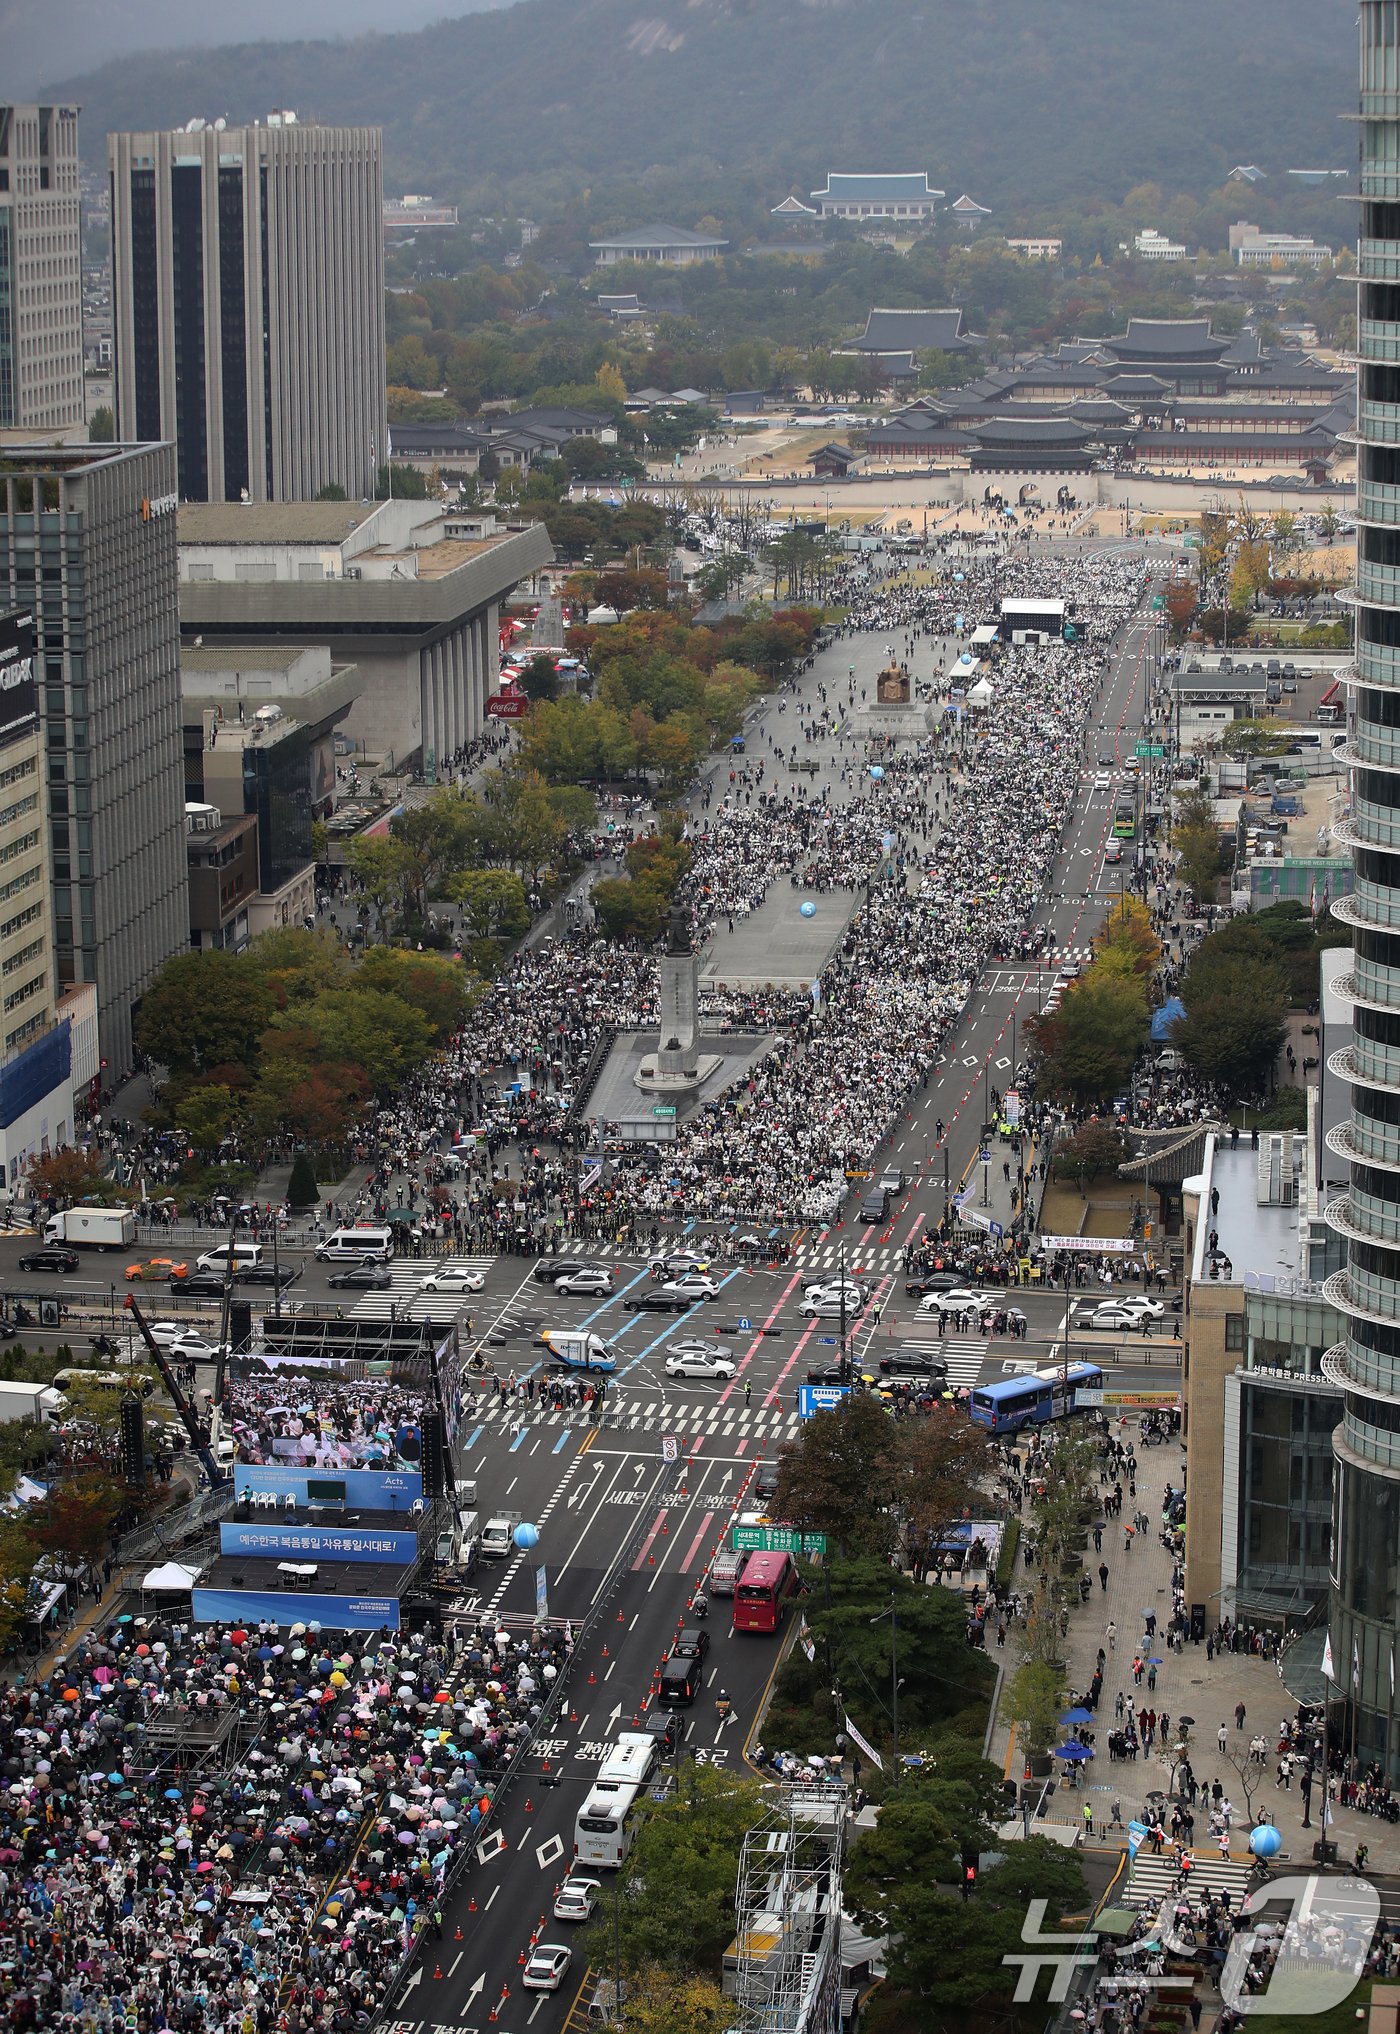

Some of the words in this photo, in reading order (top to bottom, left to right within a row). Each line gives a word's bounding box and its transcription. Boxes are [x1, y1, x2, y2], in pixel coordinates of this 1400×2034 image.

[806, 905, 812, 914] 5
[1253, 1365, 1291, 1380] 신문박물관
[385, 1476, 404, 1485] Acts
[605, 1491, 647, 1505] 서대문
[696, 1494, 736, 1510] 광화문
[737, 1531, 760, 1539] 서대문역
[239, 1534, 279, 1547] 예수한국
[281, 1536, 320, 1550] 복음통일
[322, 1538, 397, 1552] 자유통일시대로!
